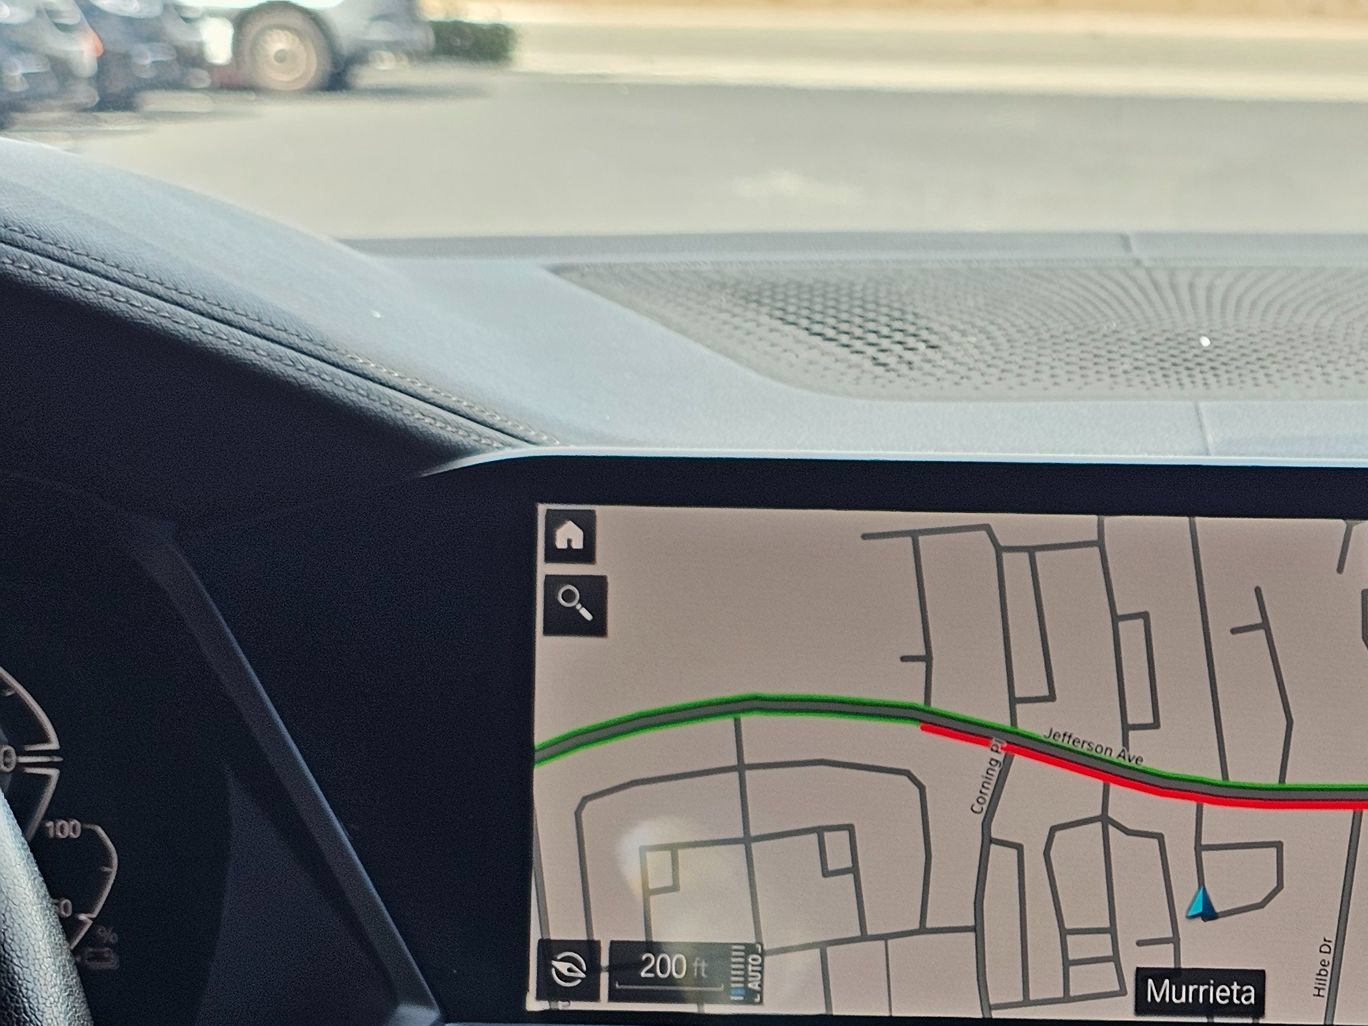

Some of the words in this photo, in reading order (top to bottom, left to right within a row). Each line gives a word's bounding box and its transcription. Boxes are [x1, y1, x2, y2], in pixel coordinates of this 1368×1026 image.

[1044, 727, 1113, 755] Jefferson
[1115, 747, 1144, 766] Ave
[970, 757, 1001, 815] Corning
[45, 818, 81, 839] 100
[1319, 936, 1333, 954] Dr
[640, 952, 687, 977] 200
[692, 957, 709, 977] ft
[747, 954, 762, 991] AUTO
[1312, 957, 1331, 998] Hilbe
[1146, 978, 1256, 1005] Murrieta
